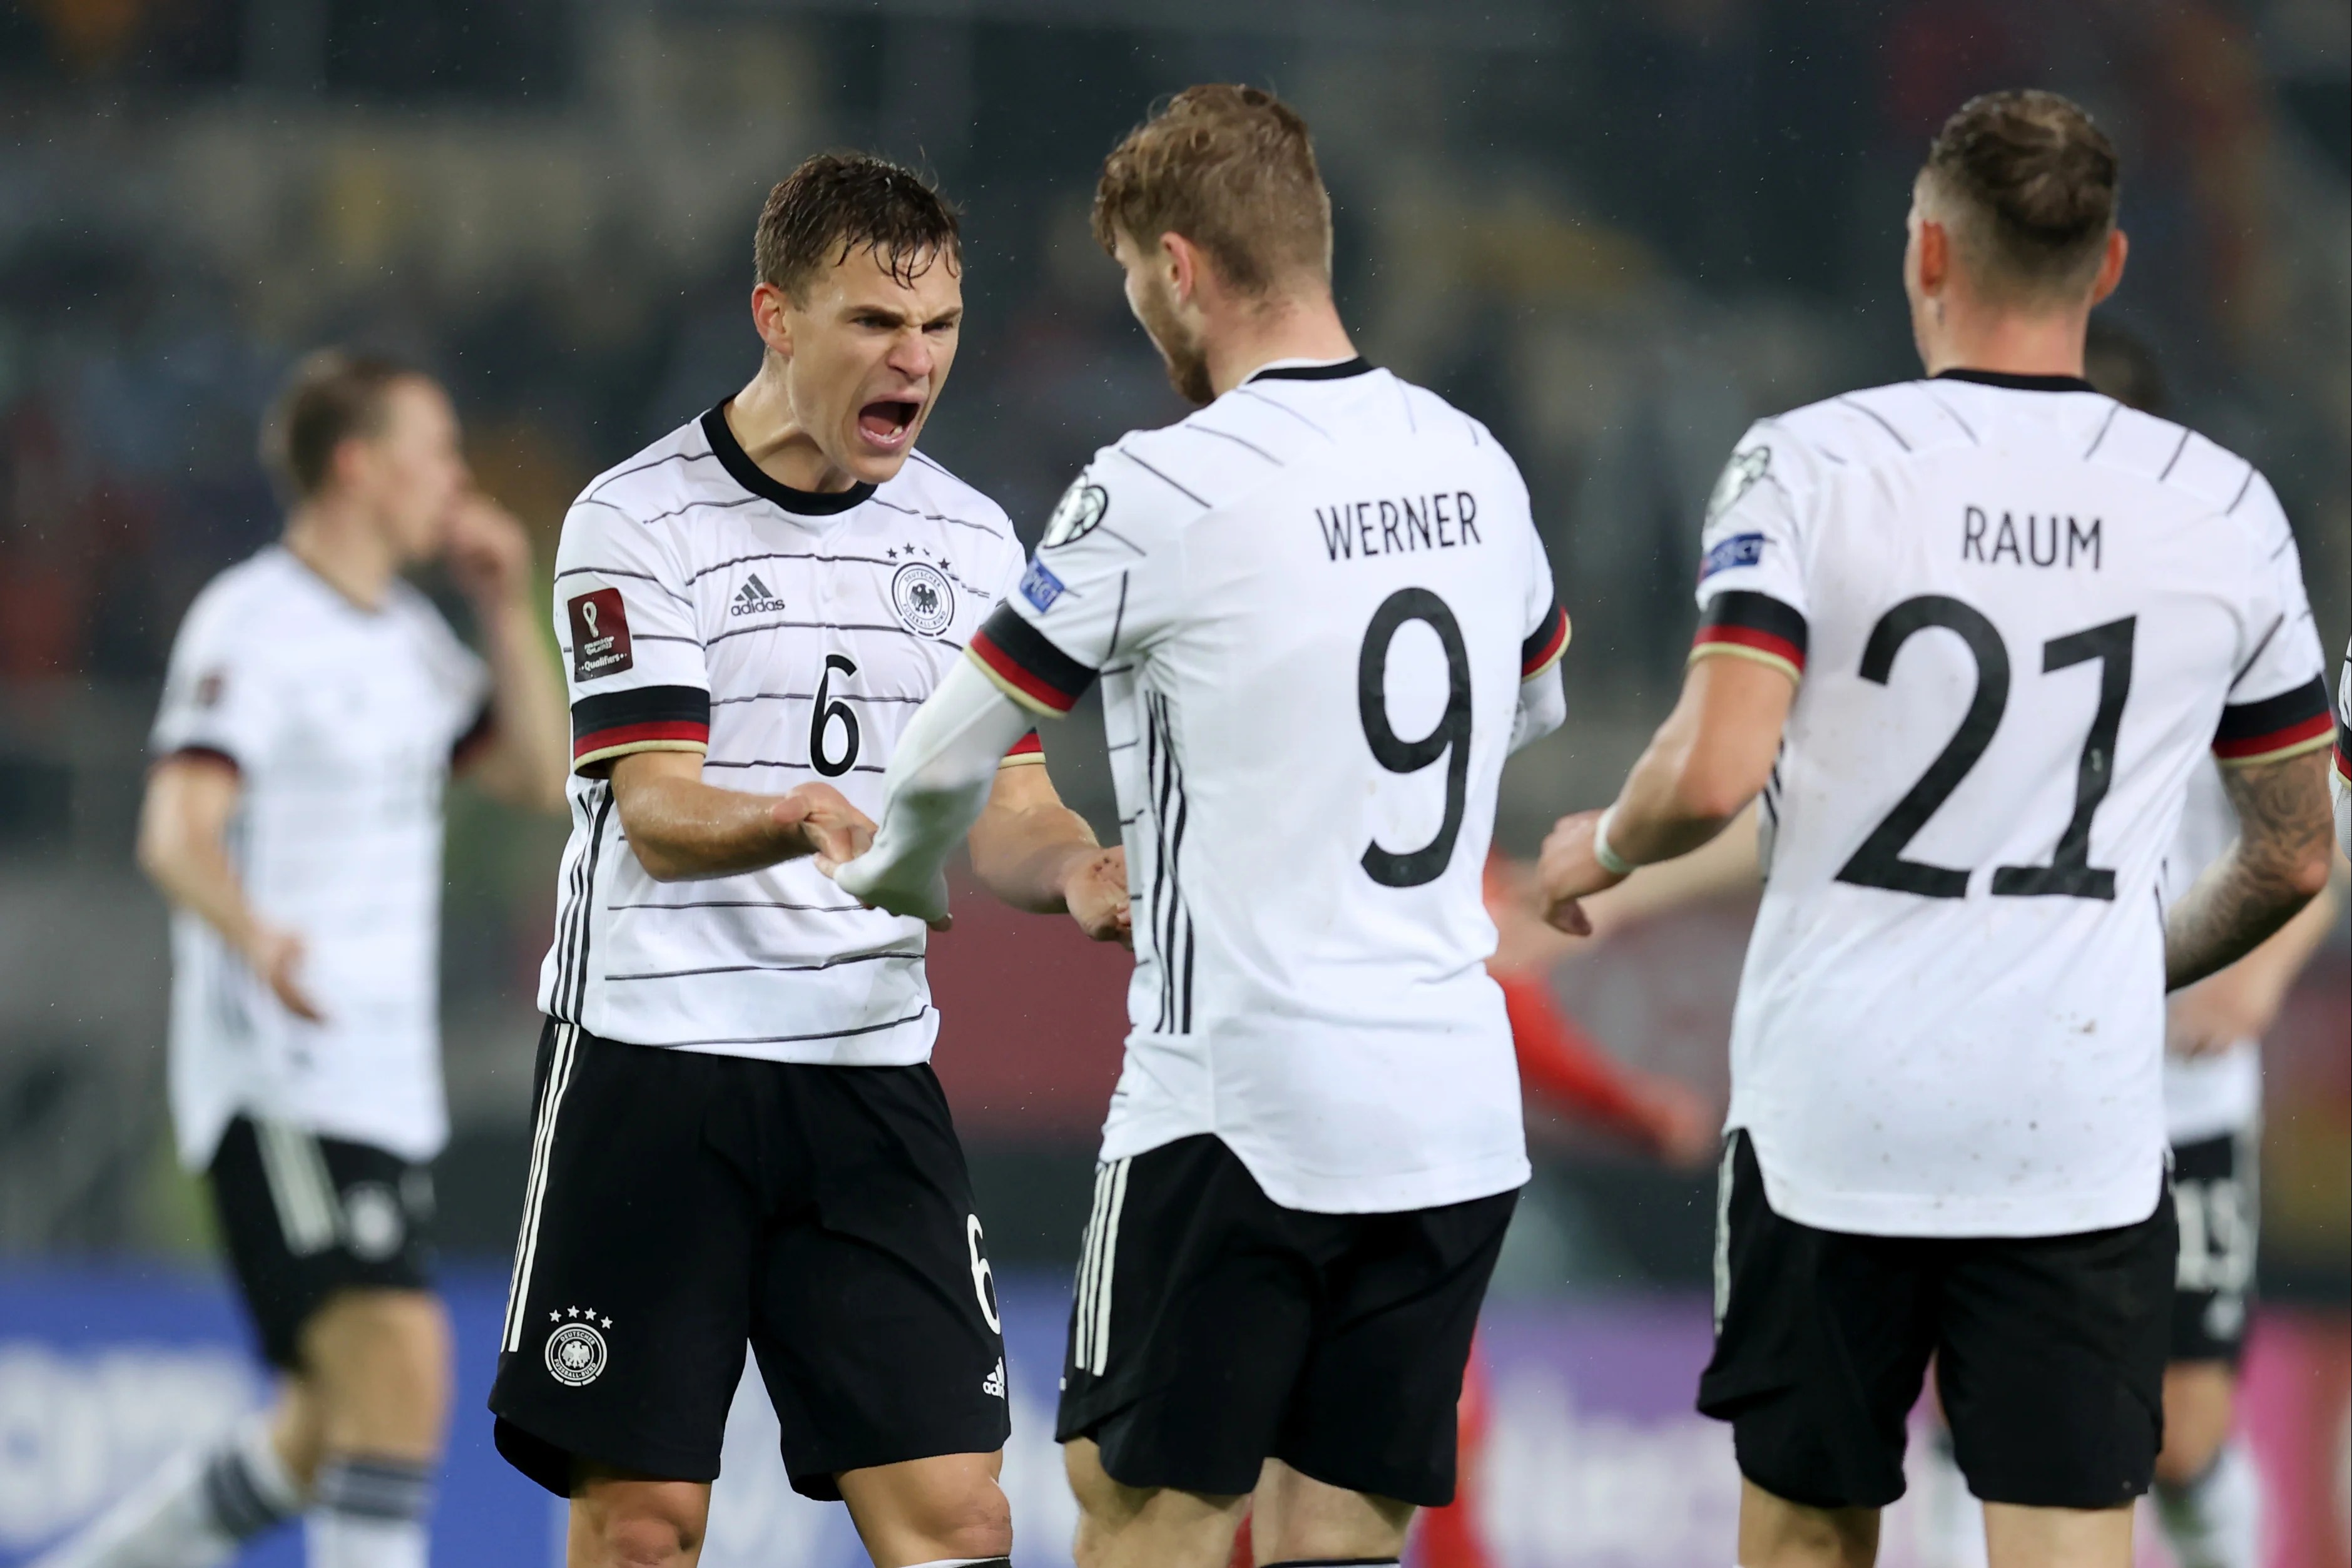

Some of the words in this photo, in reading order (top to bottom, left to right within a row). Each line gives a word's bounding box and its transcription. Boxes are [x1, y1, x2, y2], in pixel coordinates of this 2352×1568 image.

[1315, 491, 1481, 562] WERNER
[1963, 505, 2102, 571] RAUM
[731, 598, 785, 616] adidas
[904, 571, 941, 588] DEUTSCHER
[584, 653, 620, 671] Qualifiers
[810, 654, 860, 777] 6
[1357, 587, 1472, 888] 9
[1833, 594, 2137, 900] 21
[967, 1213, 1001, 1335] 6
[559, 1331, 596, 1345] DEUTSCHER
